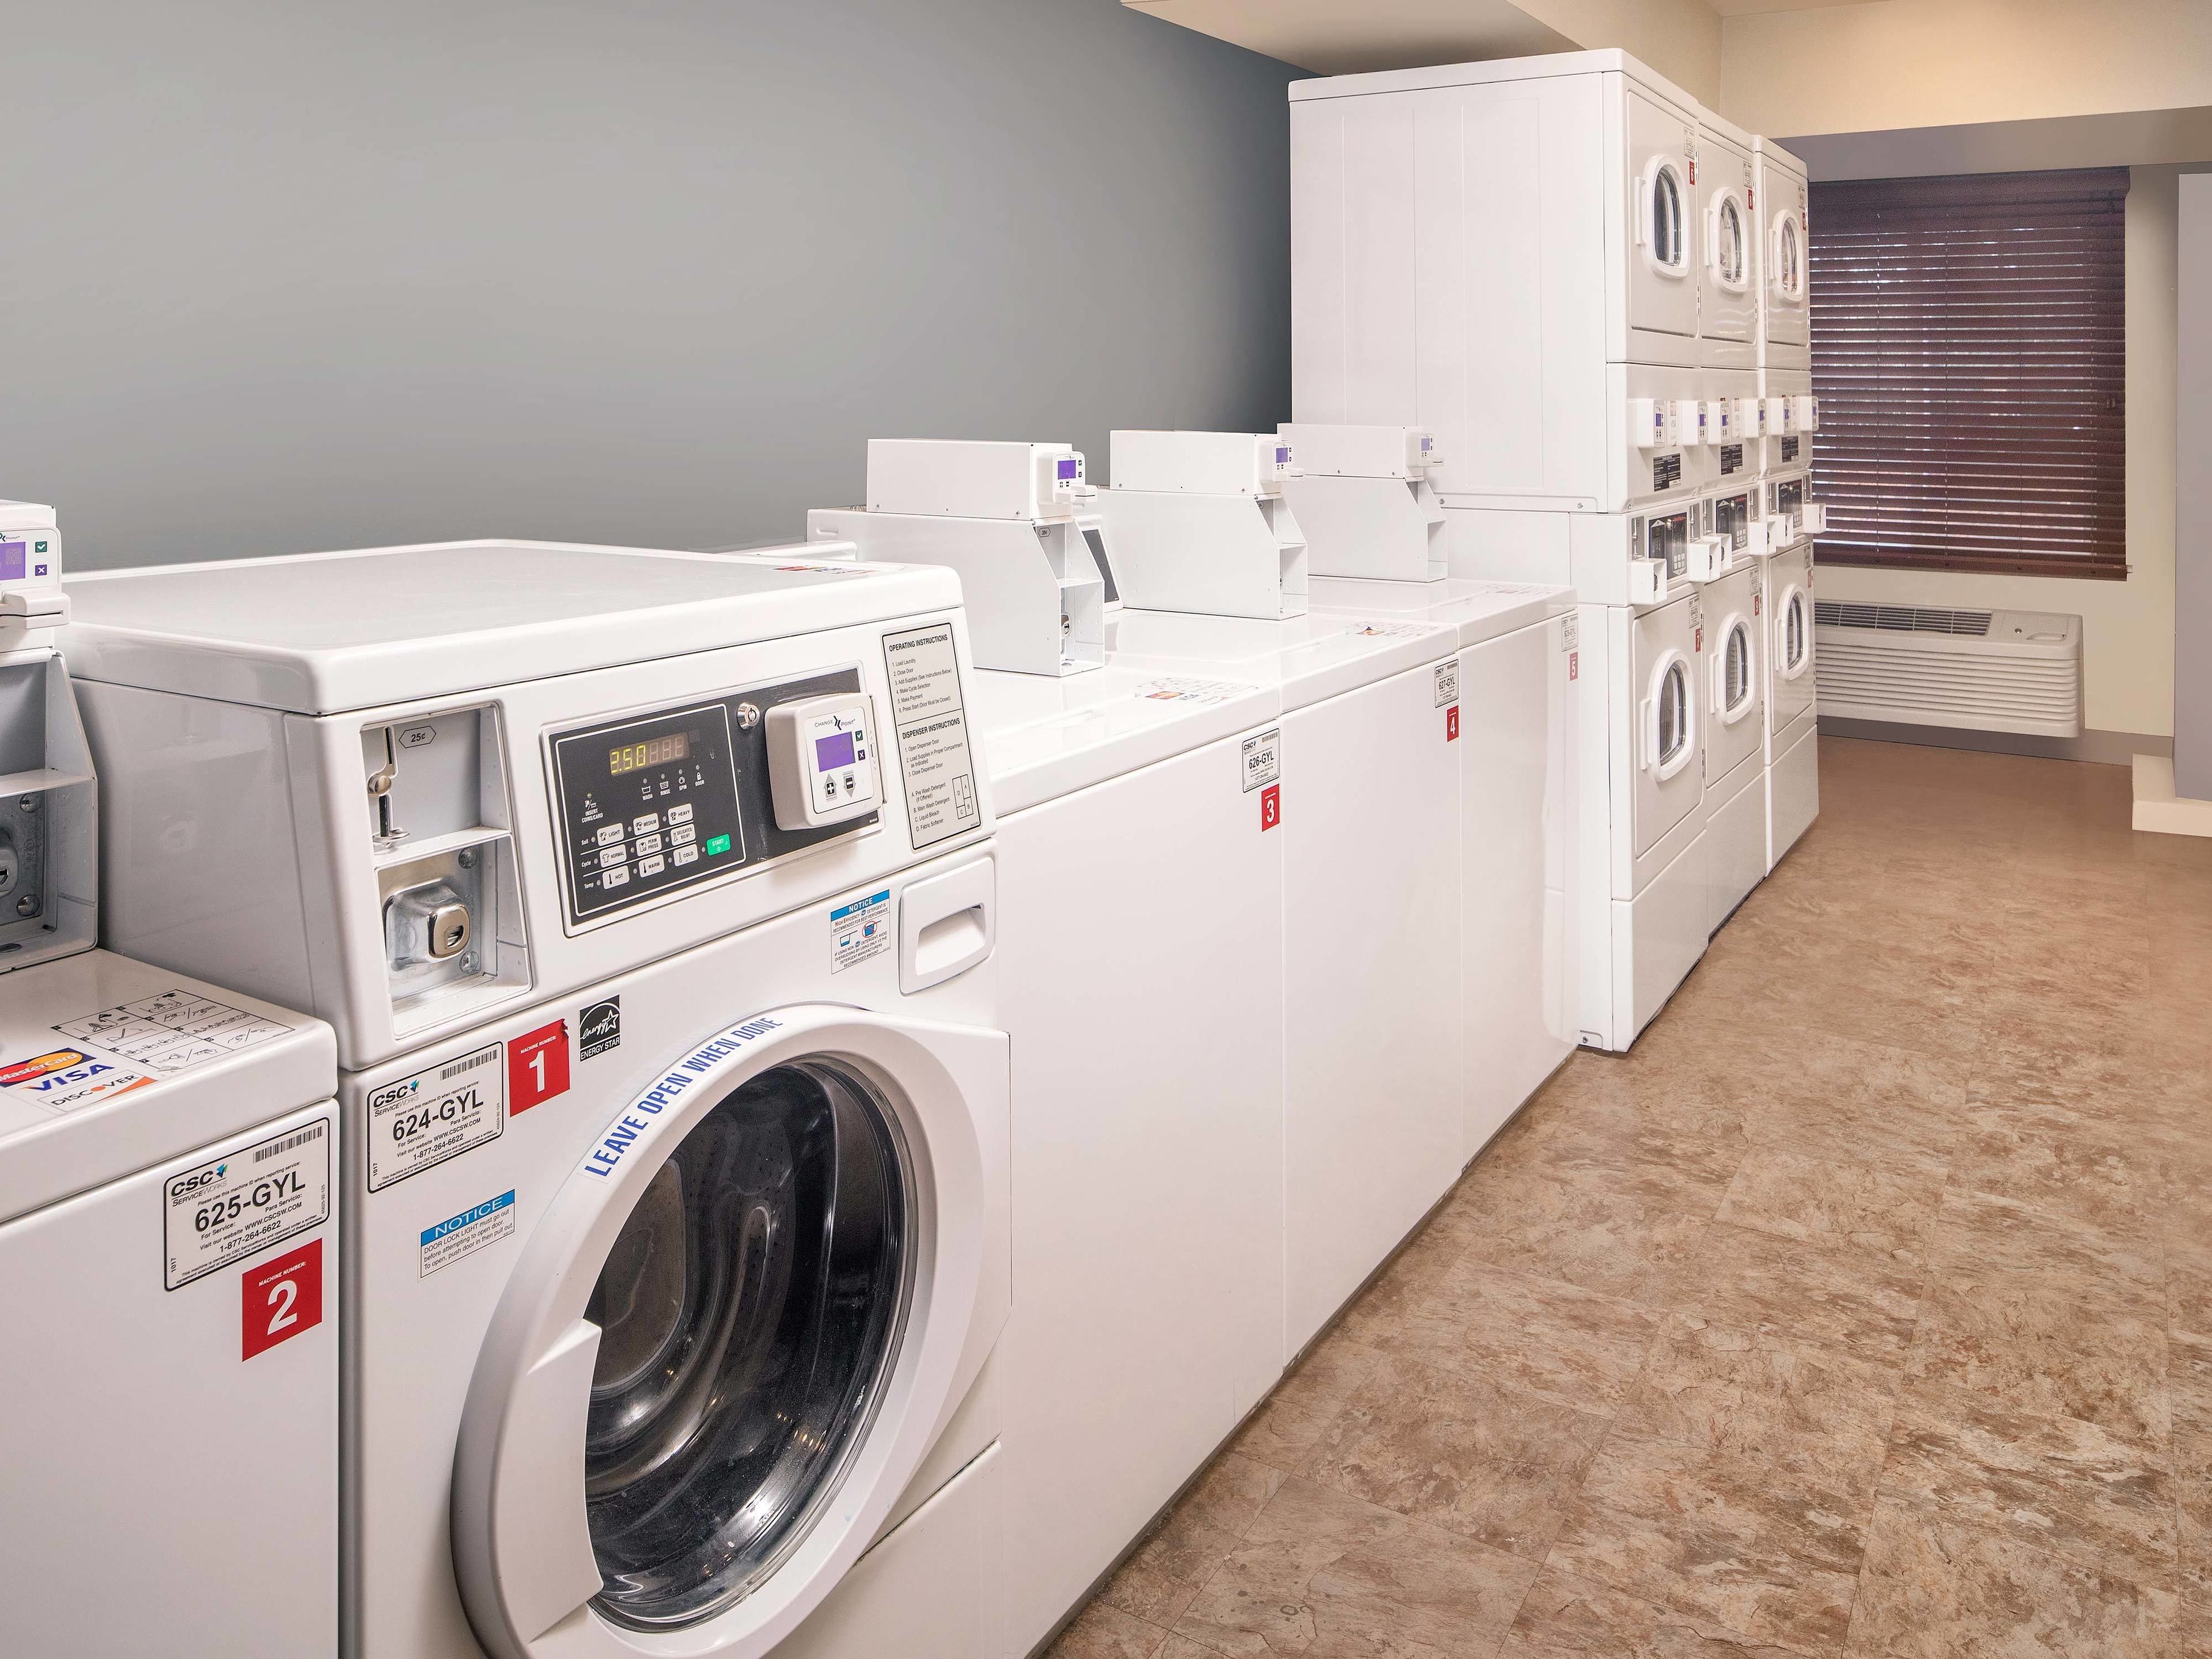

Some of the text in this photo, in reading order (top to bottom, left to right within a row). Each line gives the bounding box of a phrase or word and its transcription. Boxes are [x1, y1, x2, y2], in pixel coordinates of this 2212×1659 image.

[889, 634, 948, 652] OPERATING INSTRUCTIONS
[1571, 661, 1575, 677] 5
[411, 733, 426, 743] 25¢
[902, 717, 960, 739] DISPENSER INSTRUCTIONS
[1450, 716, 1456, 734] 4
[1244, 741, 1253, 751] CSC
[1249, 751, 1274, 770] 626-GYL
[581, 812, 603, 823] COINS/CARD
[585, 808, 598, 816] INSERT
[1267, 799, 1274, 823] 3
[712, 838, 724, 846] START
[849, 897, 872, 912] NOTICE
[520, 1035, 556, 1054] MACHINE NUMBER:
[581, 1036, 620, 1060] ENERGY STAR
[25, 1064, 115, 1091] VISA
[529, 1050, 545, 1093] 1
[51, 1074, 139, 1105] DISCOVER
[373, 1085, 408, 1107] CSC
[584, 1017, 783, 1177] LEAVE OPEN WHEN DONE
[393, 1089, 483, 1141] 624-GYL
[407, 1133, 426, 1144] Service:
[461, 1110, 480, 1121] Servicio:
[413, 1133, 463, 1160] 1-877-264-6622
[416, 1139, 432, 1149] website
[433, 1117, 480, 1141] WWW.CSCSW.COM
[171, 1171, 213, 1196] CSC
[172, 1180, 227, 1207] SERVICEWORKS
[198, 1198, 211, 1206] Please
[230, 1183, 248, 1192] machine
[266, 1168, 284, 1178] reporting
[285, 1162, 299, 1170] service:
[195, 1171, 305, 1232] 625-GYL
[212, 1222, 235, 1235] Service:
[265, 1204, 277, 1212] Para
[279, 1194, 302, 1206] Servicio:
[200, 1242, 211, 1250] Visit
[223, 1229, 243, 1240] website
[244, 1201, 301, 1230] WWW.CSCSW.COM
[434, 1196, 502, 1237] NOTICE
[220, 1220, 281, 1252] 1-877-264-6622
[424, 1240, 442, 1253] DOOR
[444, 1232, 460, 1244] LOCK
[461, 1222, 478, 1236] LIGHT
[479, 1217, 492, 1227] must
[501, 1209, 509, 1217] out
[424, 1250, 441, 1262] before
[442, 1236, 469, 1253] attempting
[477, 1226, 490, 1236] open
[491, 1219, 503, 1229] door.
[431, 1256, 446, 1266] open,
[448, 1248, 461, 1259] push
[462, 1241, 474, 1251] door
[482, 1233, 493, 1241] then
[494, 1226, 503, 1237] pull
[504, 1222, 513, 1230] out.
[258, 1261, 306, 1287] MACHINE NUMBER:
[267, 1280, 297, 1336] 2
